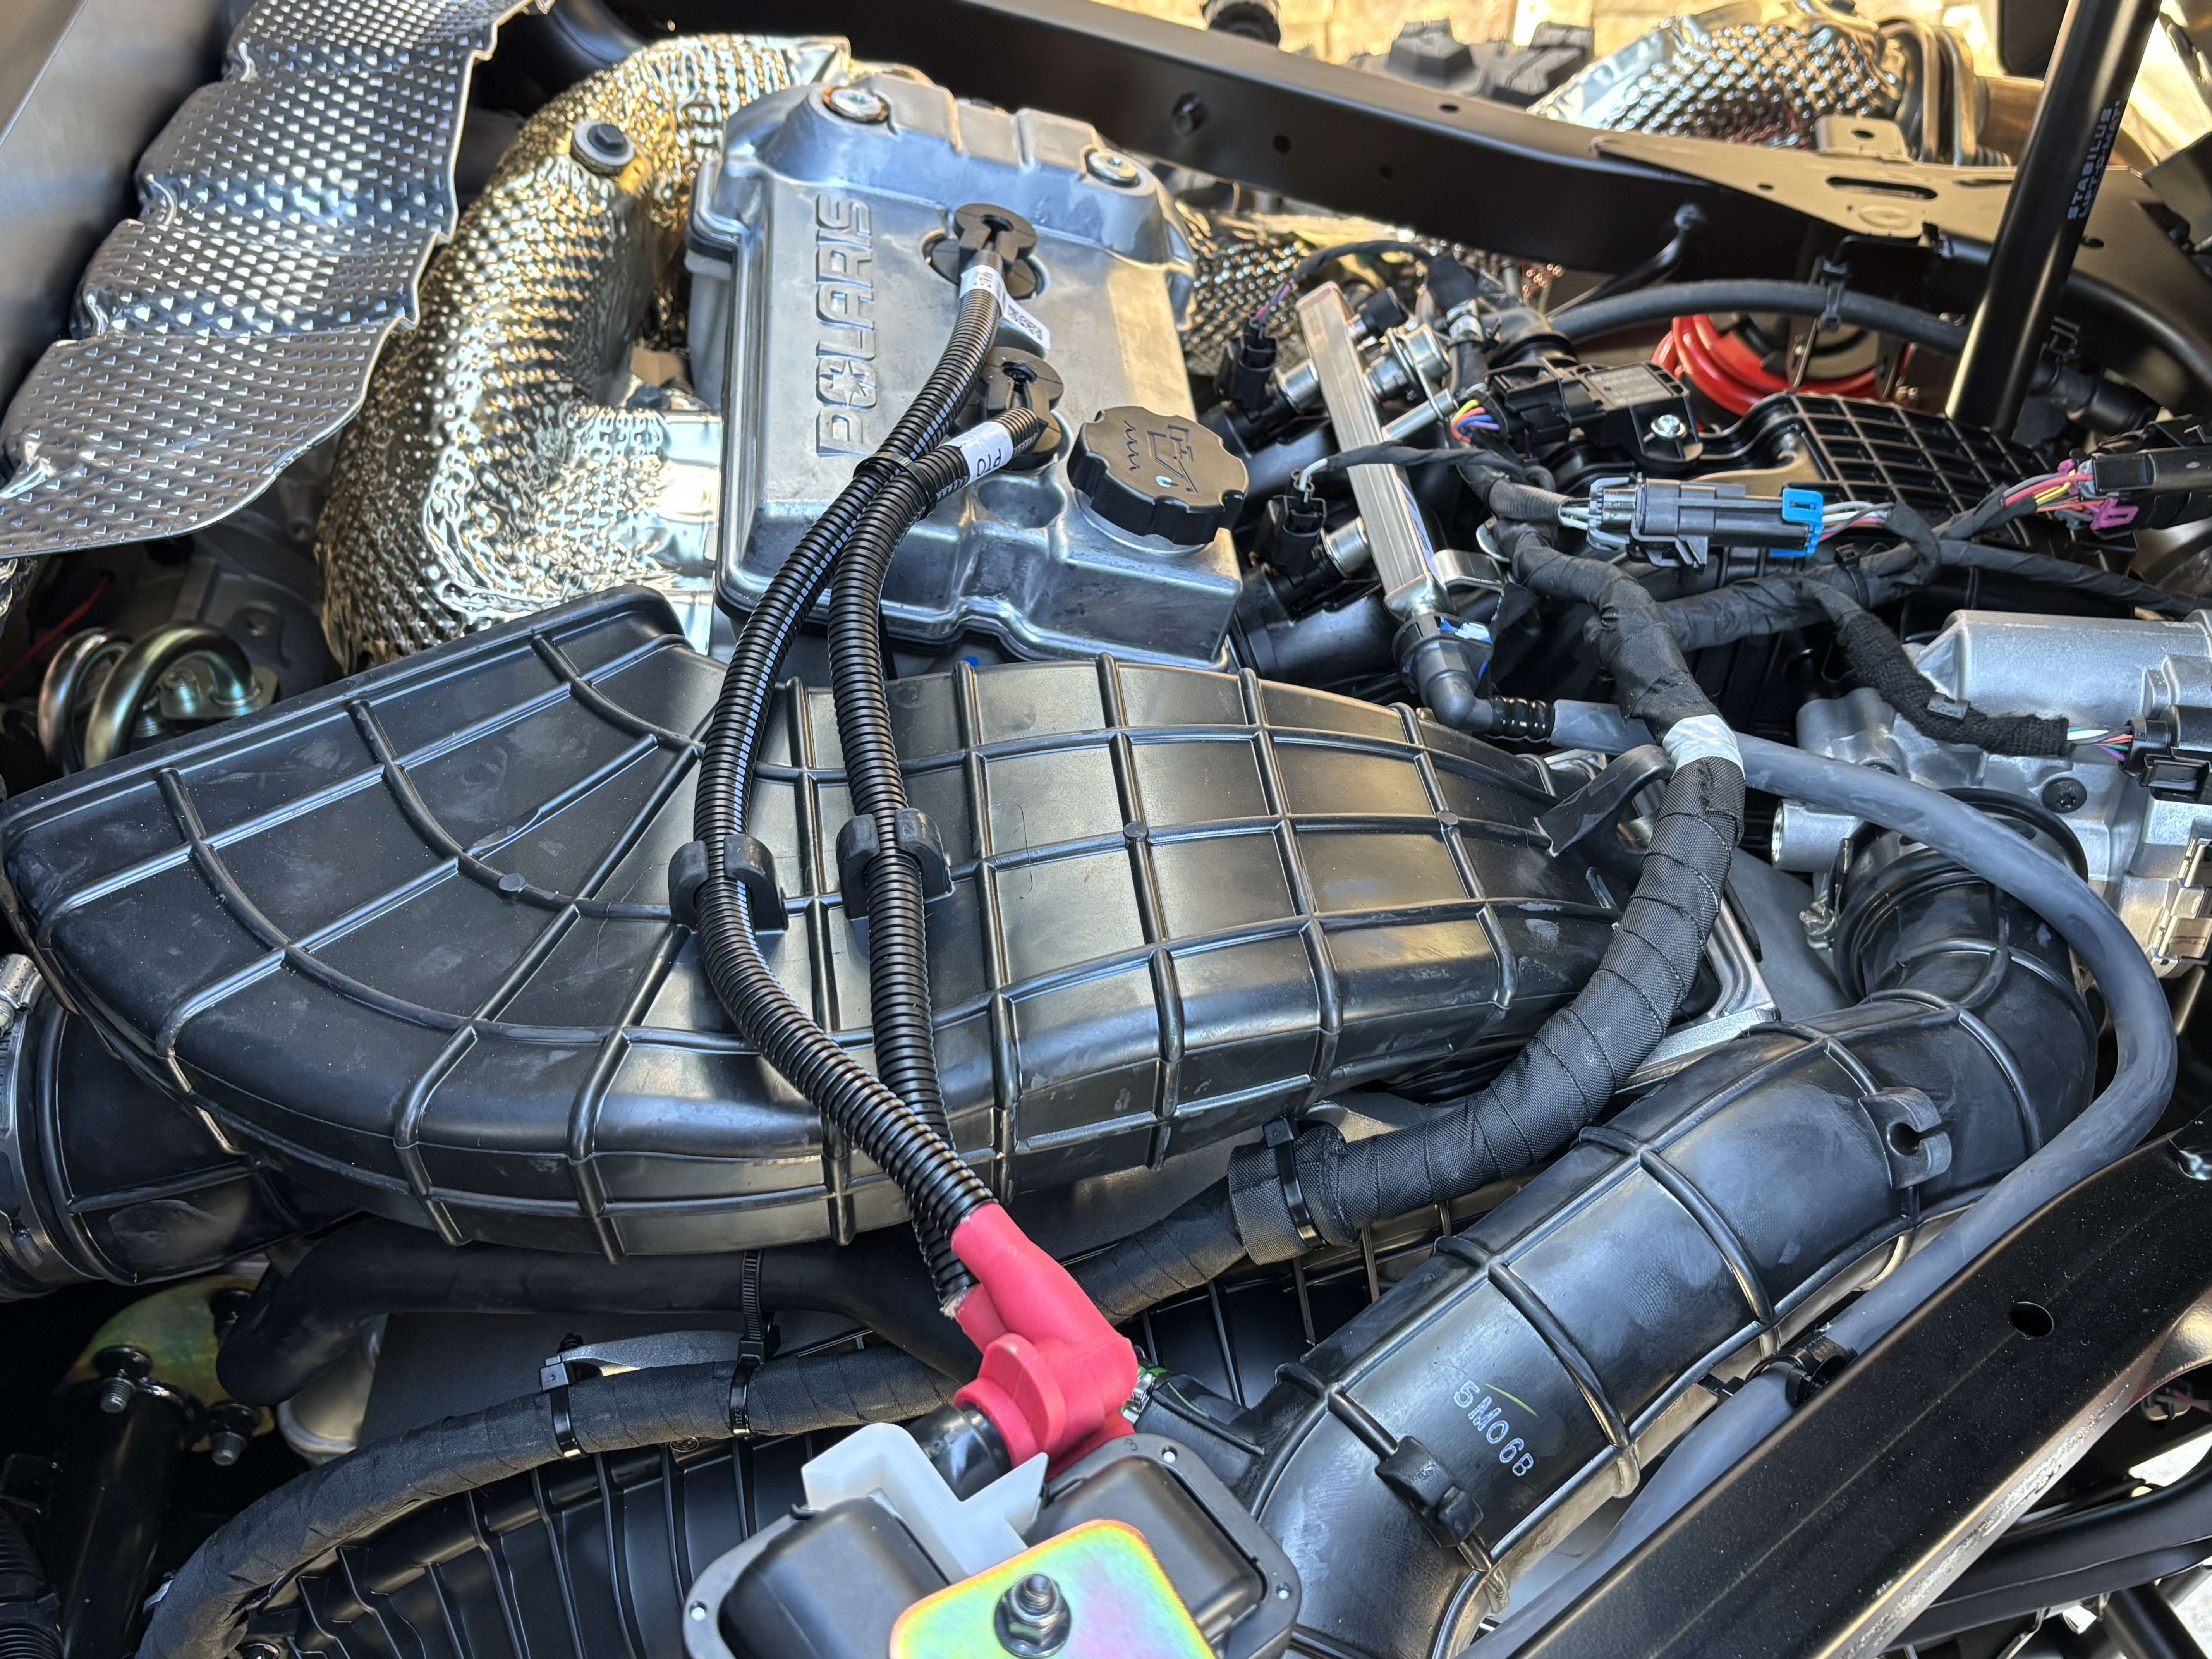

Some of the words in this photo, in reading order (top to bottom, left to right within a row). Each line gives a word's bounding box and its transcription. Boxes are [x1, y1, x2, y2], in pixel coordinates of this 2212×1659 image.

[2067, 108, 2112, 220] STABILUS
[816, 194, 876, 457] POLARIS
[977, 448, 1001, 477] PTO
